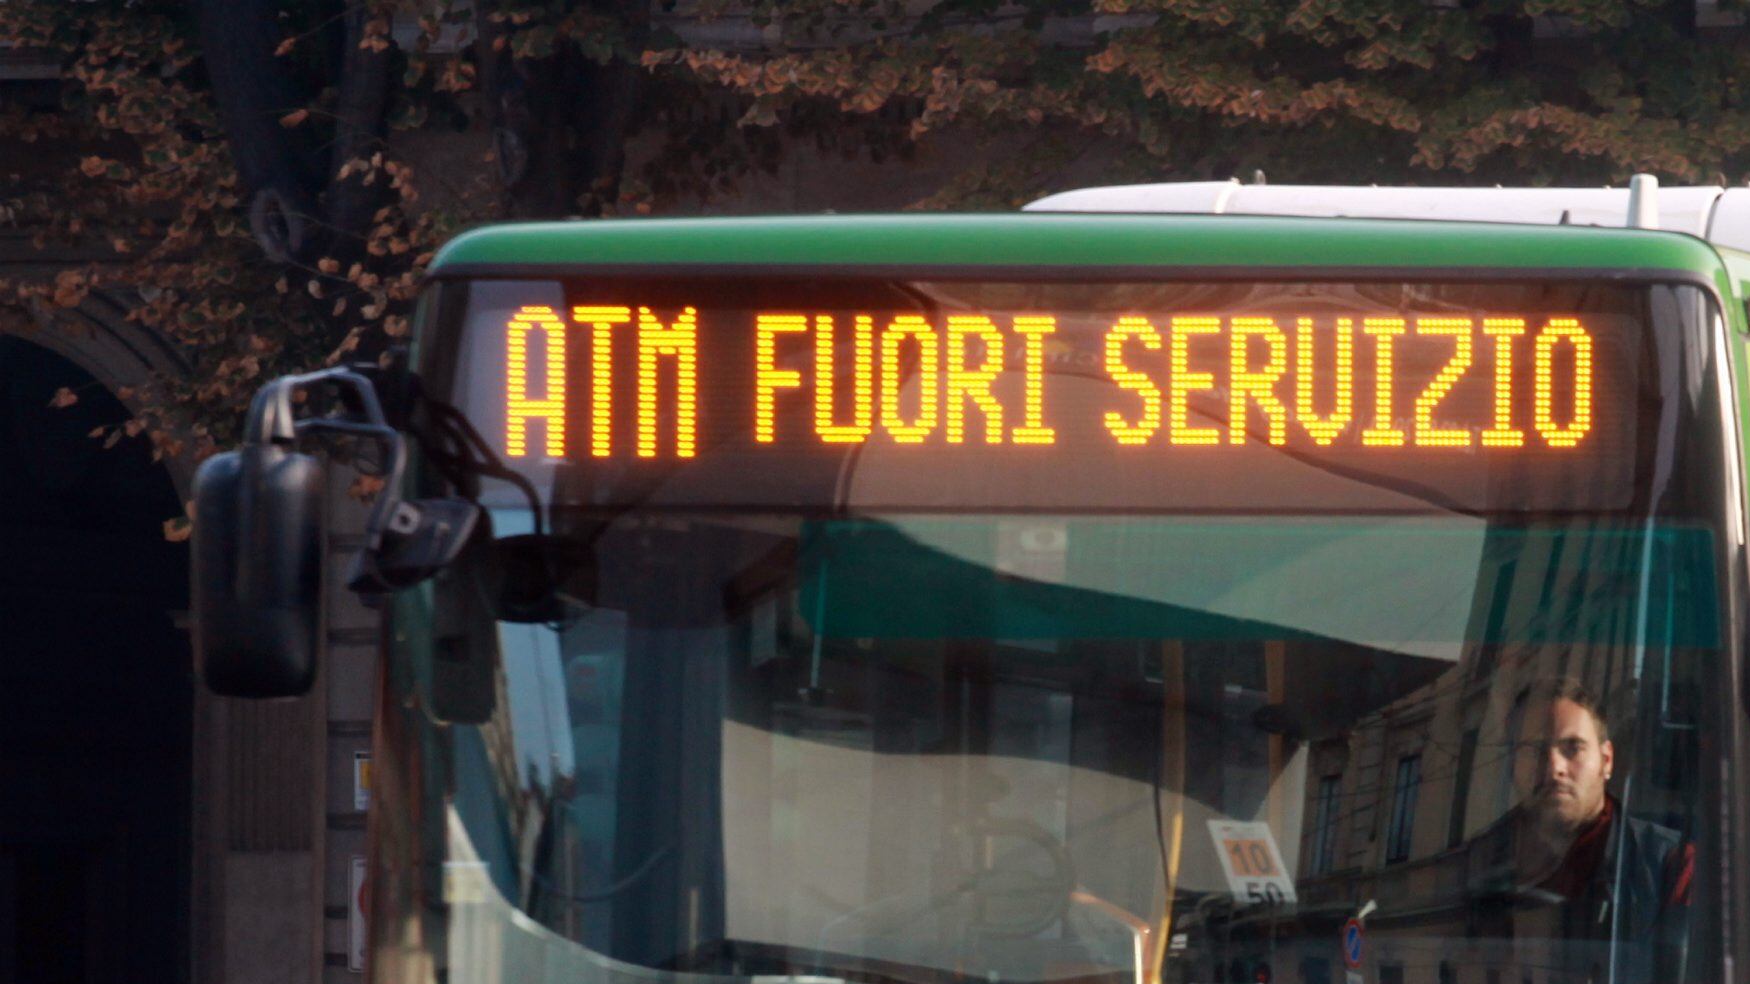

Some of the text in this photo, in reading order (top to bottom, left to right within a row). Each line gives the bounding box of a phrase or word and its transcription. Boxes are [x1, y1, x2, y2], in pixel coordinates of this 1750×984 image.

[507, 305, 1593, 457] ATM FUORI SERVIZIO
[1232, 842, 1273, 875] 10
